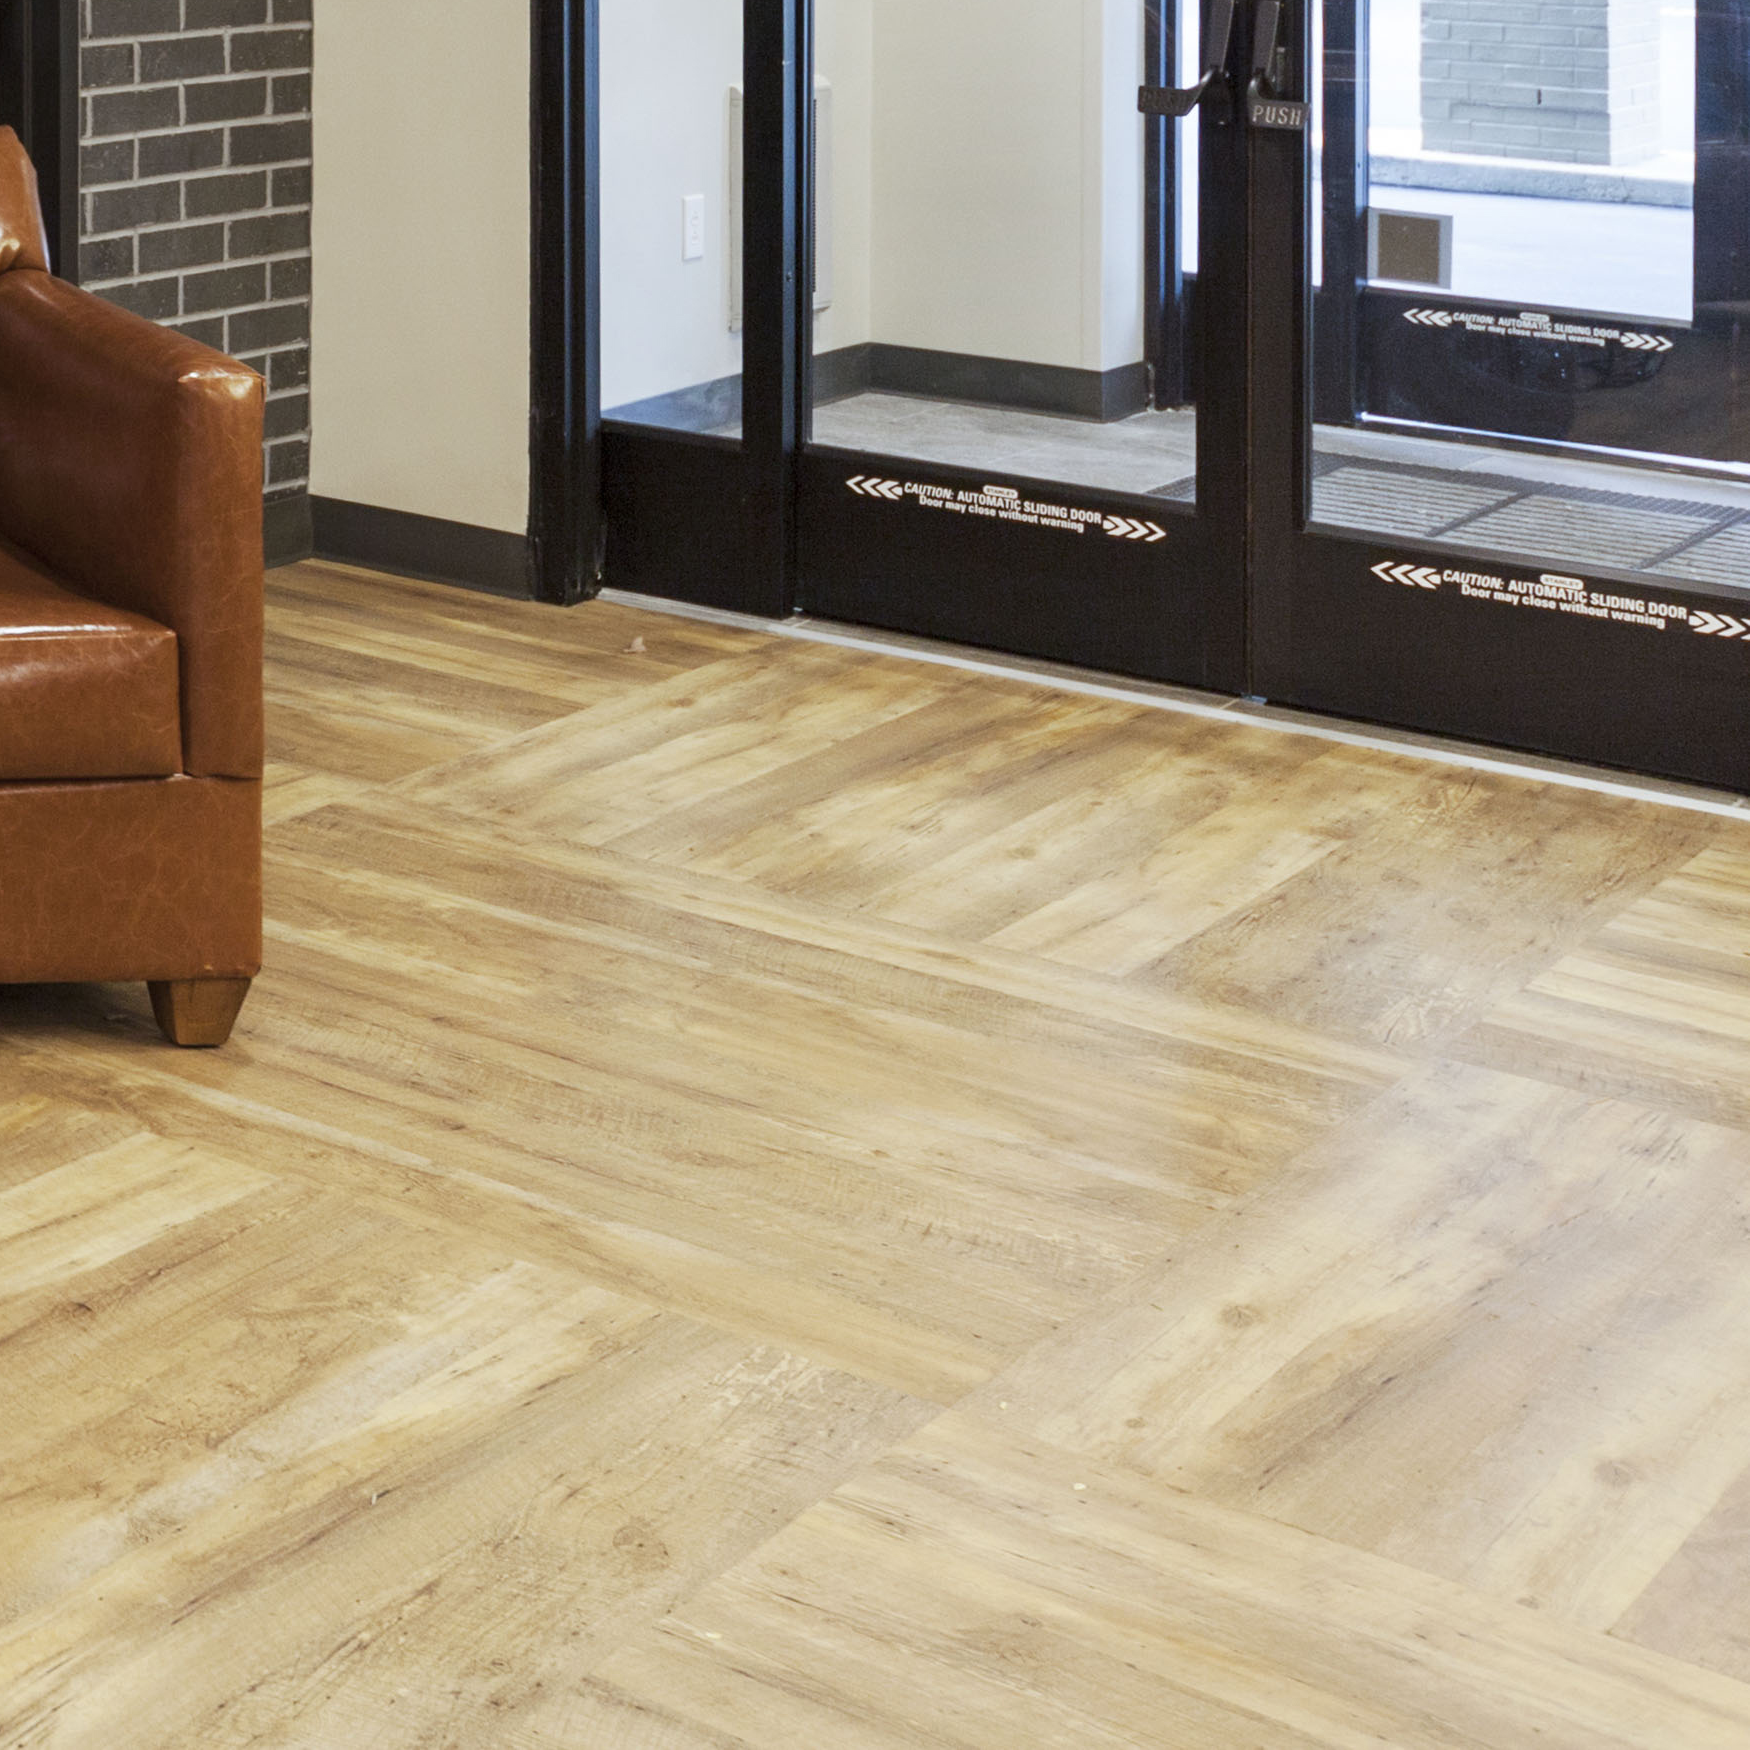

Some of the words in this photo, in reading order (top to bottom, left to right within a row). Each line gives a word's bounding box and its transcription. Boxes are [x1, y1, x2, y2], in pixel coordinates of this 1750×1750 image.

[1252, 105, 1302, 126] PUSH
[1453, 312, 1494, 325] CAUTION:
[1498, 317, 1552, 331] AUTOMATIC
[1554, 324, 1591, 336] SLIDING
[1593, 328, 1620, 339] DOOR
[904, 482, 954, 500] CAUTION:
[957, 490, 1021, 511] AUTOMATIC
[1024, 501, 1068, 518] SLIDING
[1070, 508, 1102, 524] DOOR
[919, 496, 943, 508] Door
[945, 500, 966, 514] may
[968, 504, 996, 517] close
[999, 507, 1038, 524] without
[1040, 515, 1085, 534] warning
[1442, 570, 1504, 590] CAUTION:
[1508, 580, 1588, 604] AUTOMATIC
[1590, 592, 1645, 613] SLIDING
[1648, 602, 1687, 620] DOOR
[1462, 584, 1491, 598] Door
[1494, 590, 1519, 605] may
[1522, 594, 1557, 610] close
[1559, 600, 1609, 619] without
[1611, 610, 1666, 630] warning
